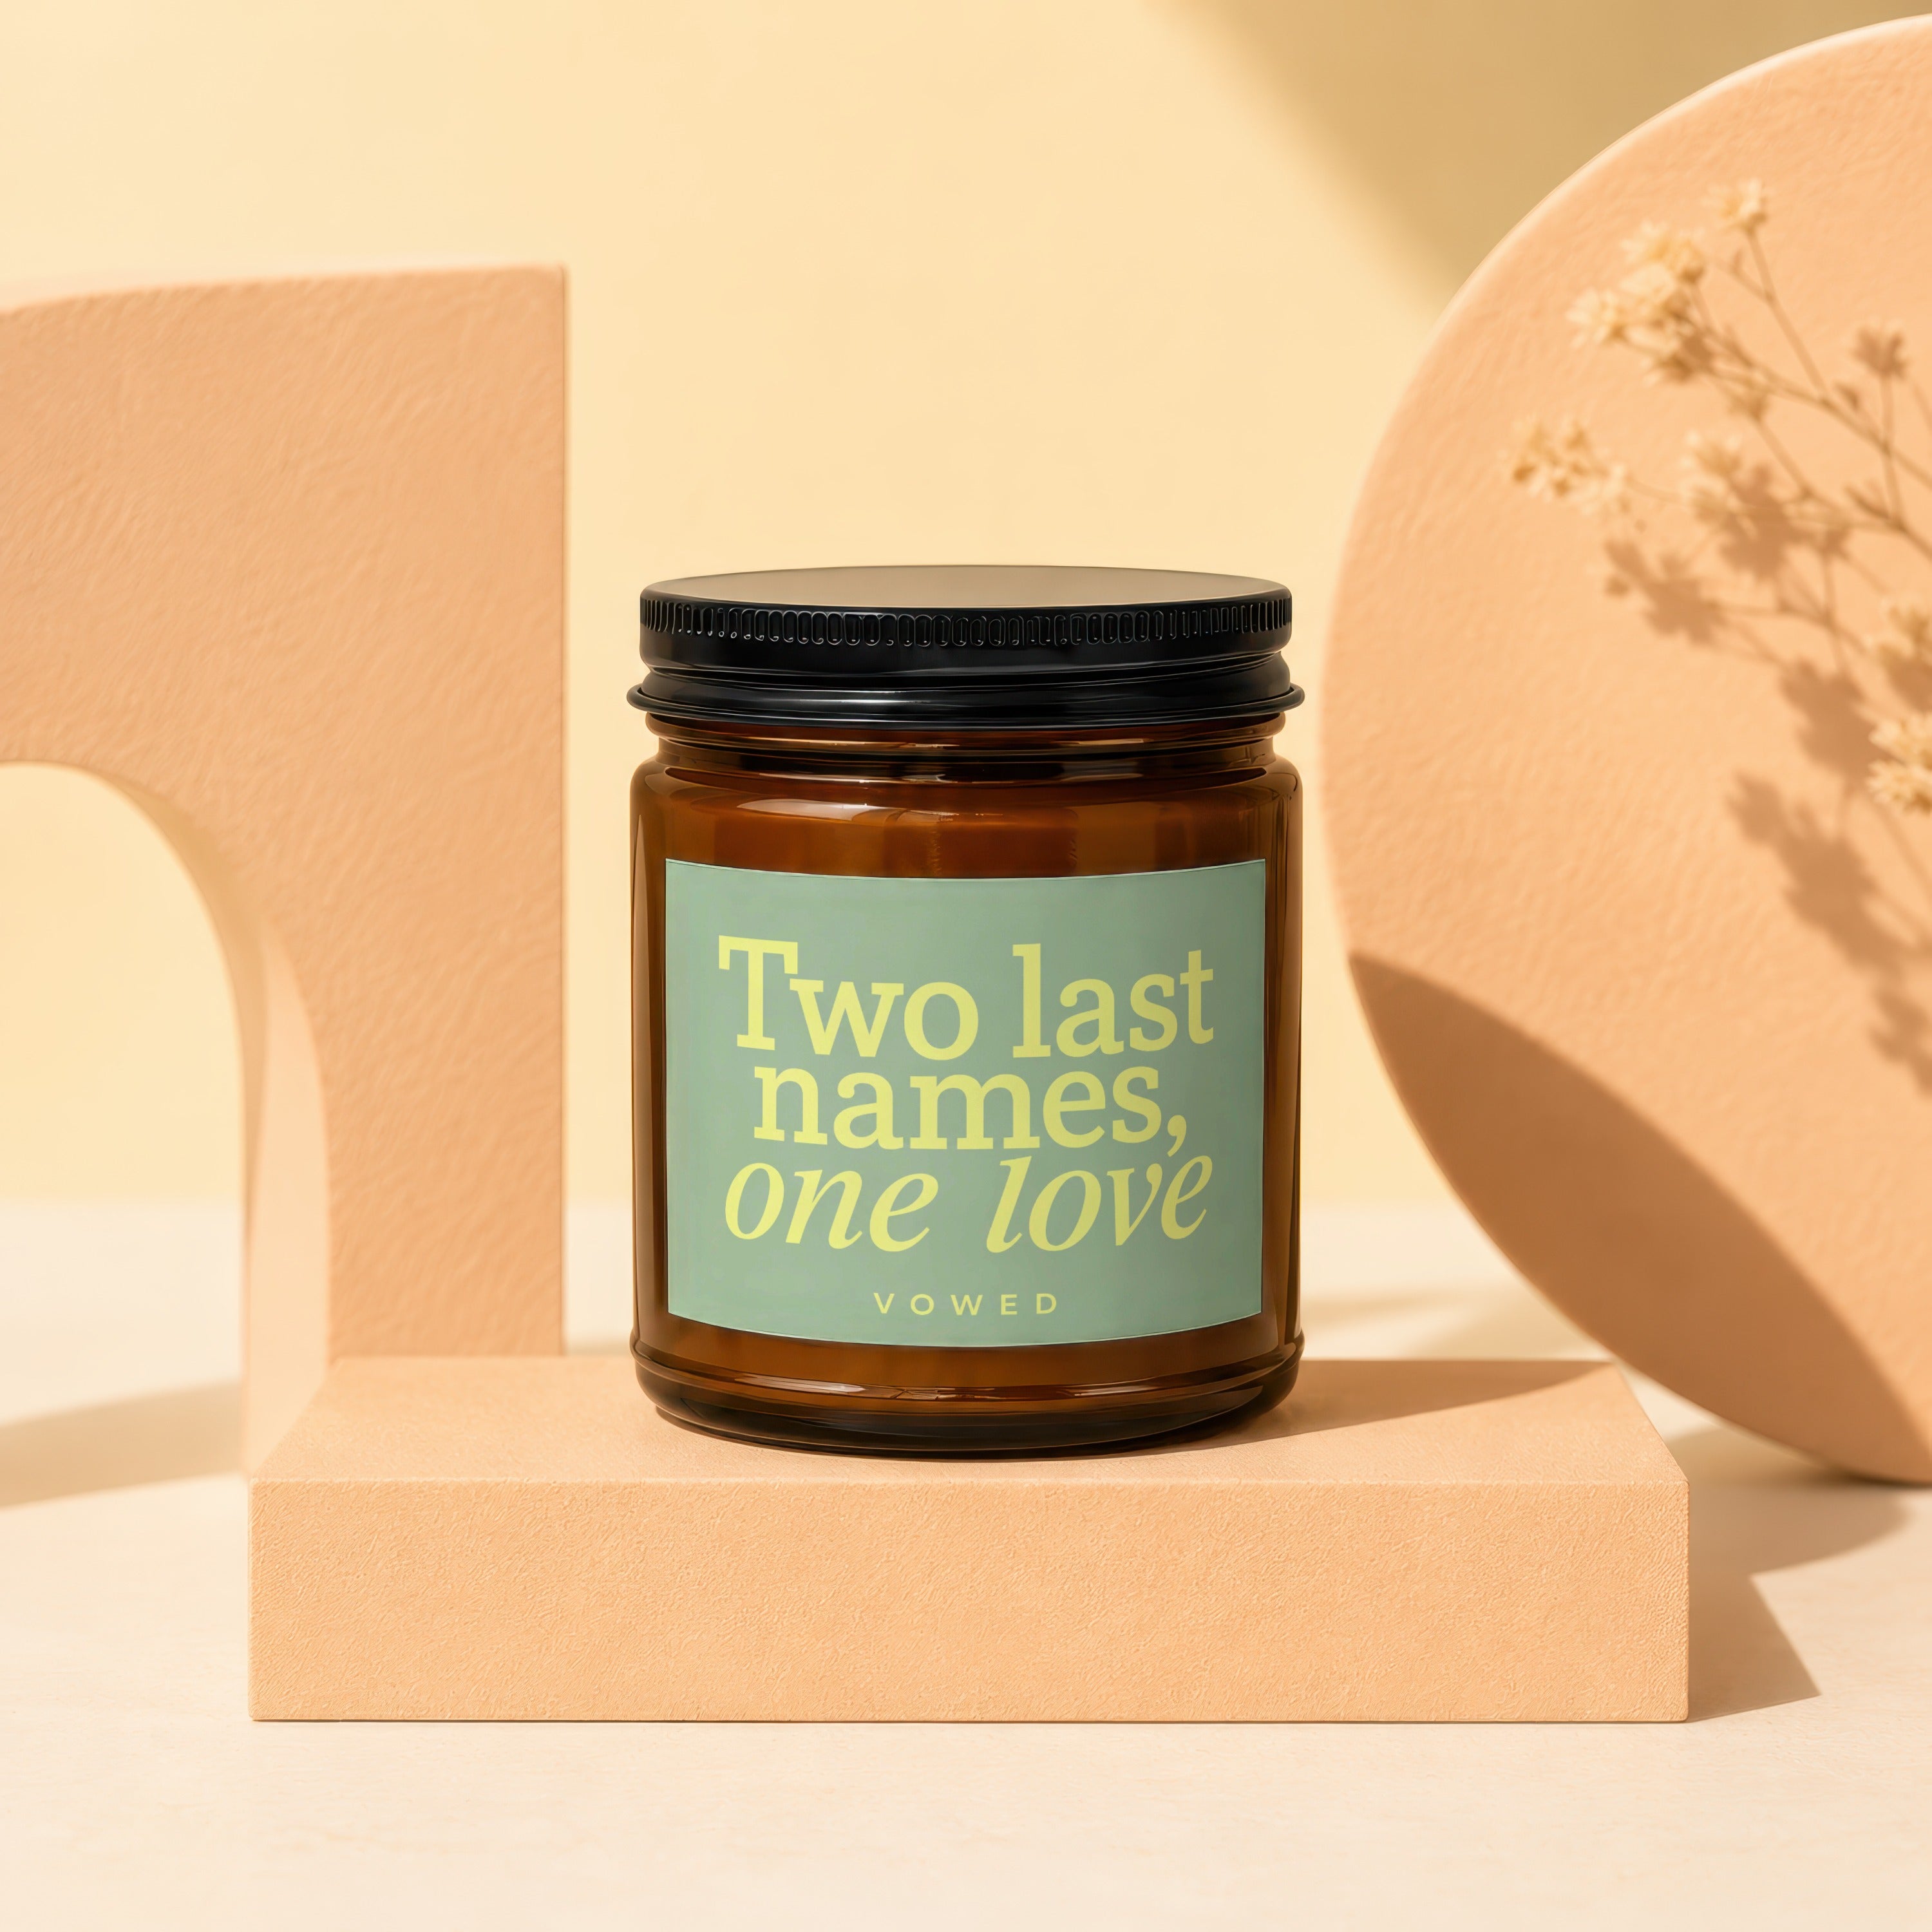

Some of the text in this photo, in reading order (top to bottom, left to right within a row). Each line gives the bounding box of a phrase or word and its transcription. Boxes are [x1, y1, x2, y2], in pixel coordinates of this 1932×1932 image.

[718, 934, 1215, 1061] Two last
[753, 1066, 1187, 1157] names,
[724, 1155, 1213, 1253] one love
[873, 1292, 1057, 1316] VOWED
